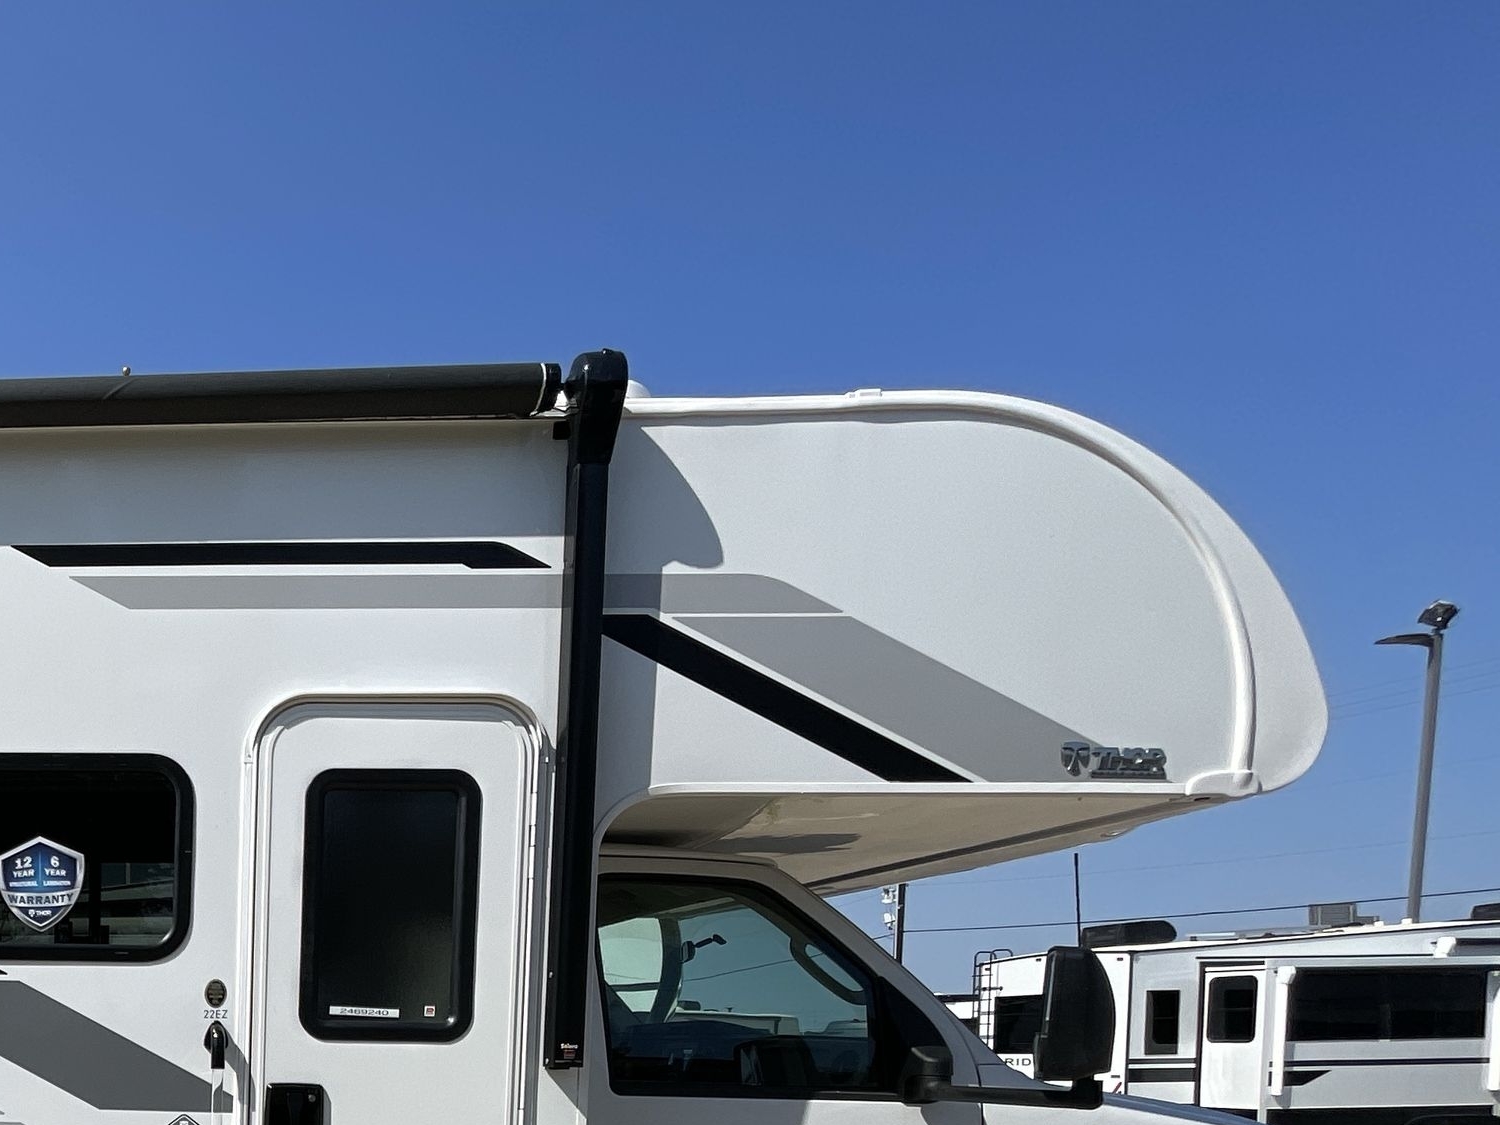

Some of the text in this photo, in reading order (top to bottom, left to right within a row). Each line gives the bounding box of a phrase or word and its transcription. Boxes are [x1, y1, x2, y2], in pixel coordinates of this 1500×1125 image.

[14, 855, 60, 869] 12 6
[12, 868, 67, 878] YEAR YEAR
[7, 893, 74, 905] WARRANTY
[203, 1009, 228, 1019] 22EZ
